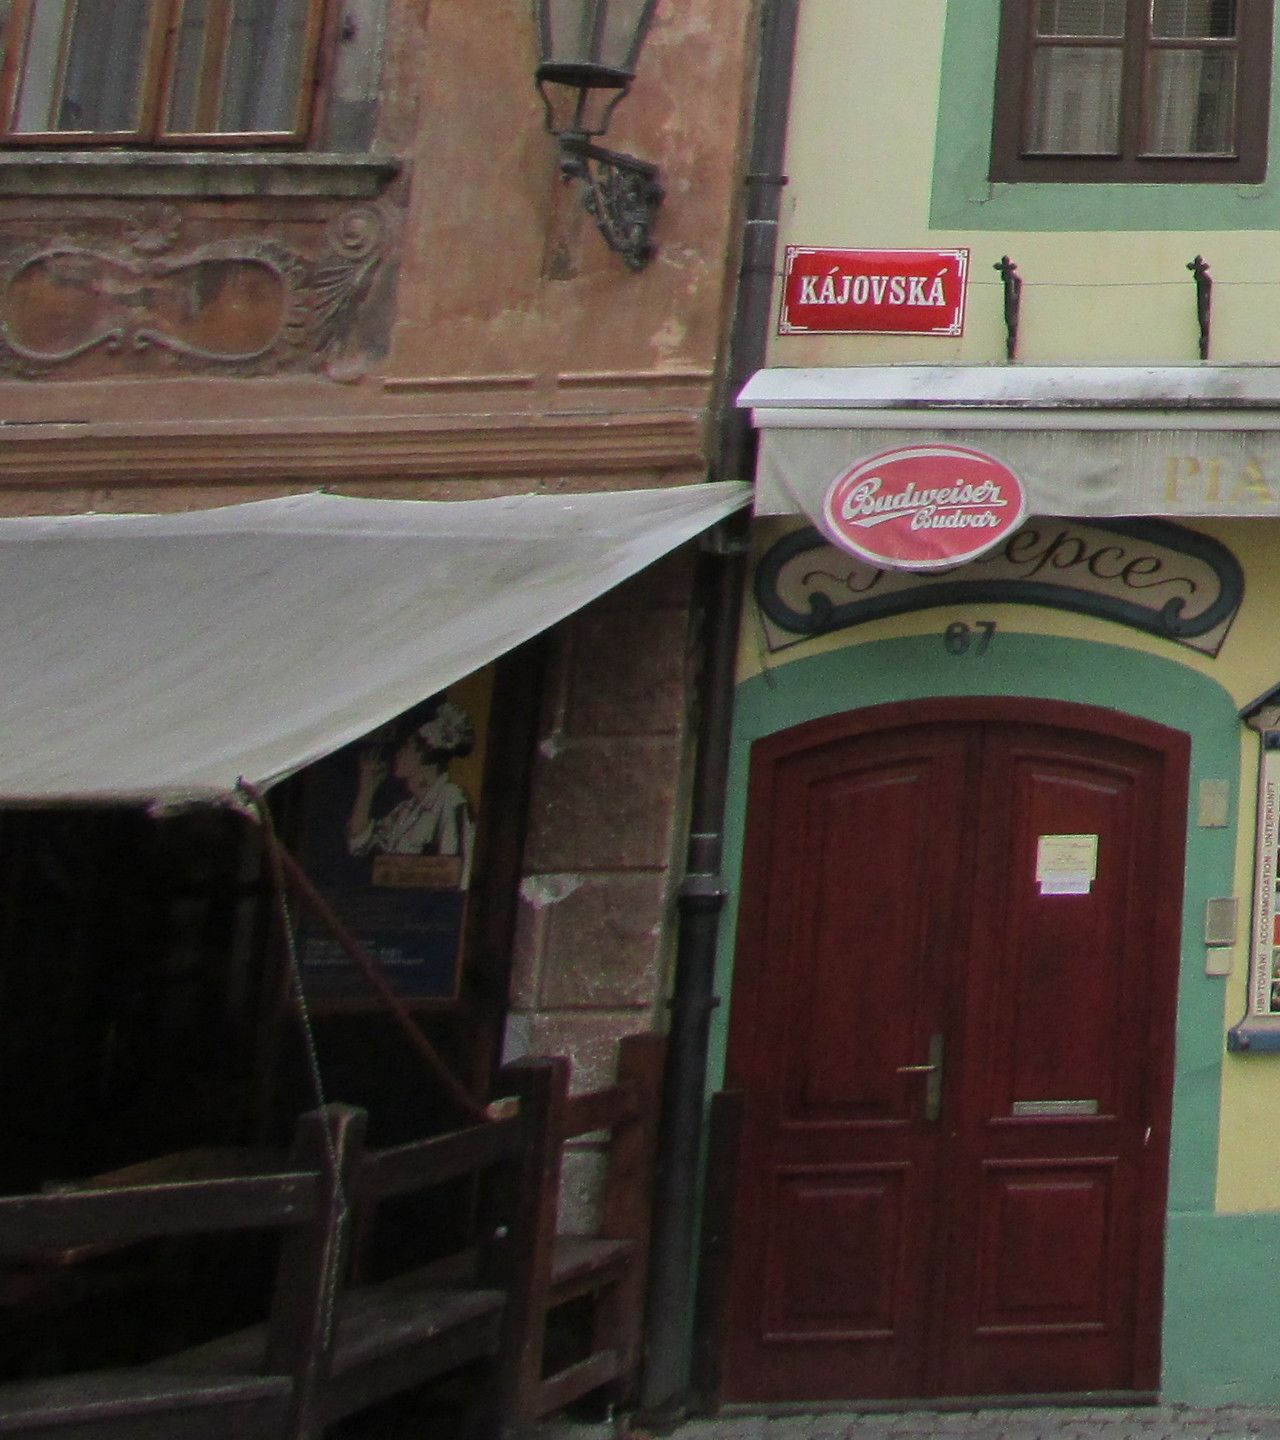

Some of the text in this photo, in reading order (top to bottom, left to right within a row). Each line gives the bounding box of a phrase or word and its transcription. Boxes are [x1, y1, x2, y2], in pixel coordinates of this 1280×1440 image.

[799, 266, 948, 306] KÁJOVSKÁ
[842, 477, 1008, 520] Budweiser
[911, 506, 1001, 531] Budvar
[1260, 855, 1273, 946] ACCOMMODATION
